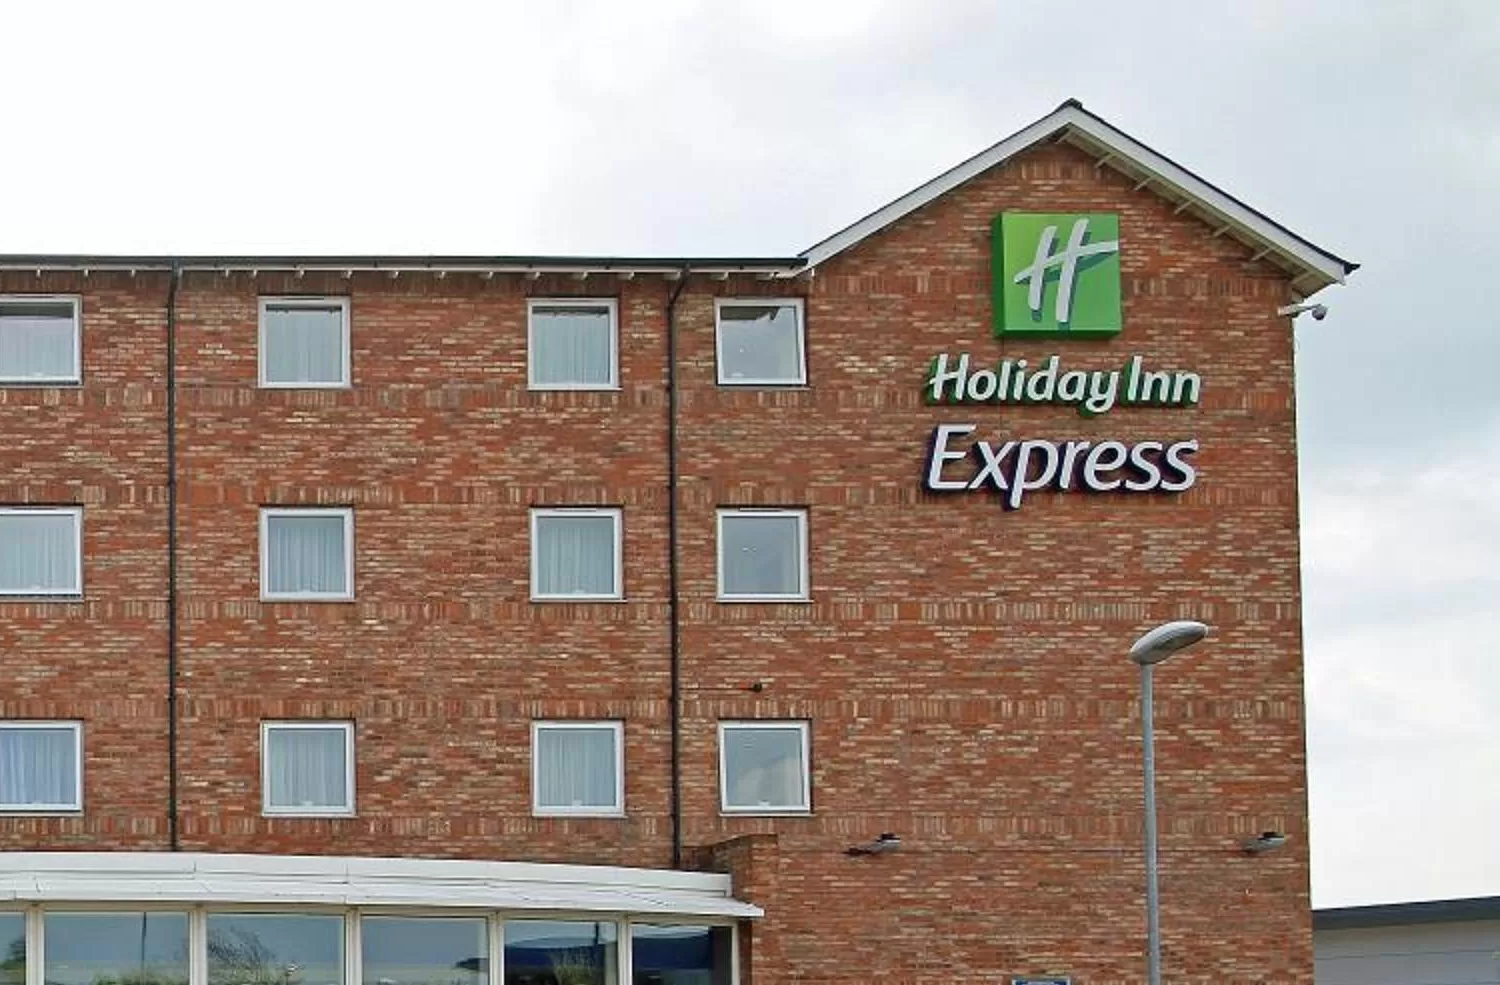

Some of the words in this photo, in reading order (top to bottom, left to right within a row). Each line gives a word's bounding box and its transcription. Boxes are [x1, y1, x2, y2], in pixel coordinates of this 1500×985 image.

[927, 353, 1119, 413] Holiday
[1123, 355, 1201, 403] Inn
[925, 423, 1199, 510] Express
